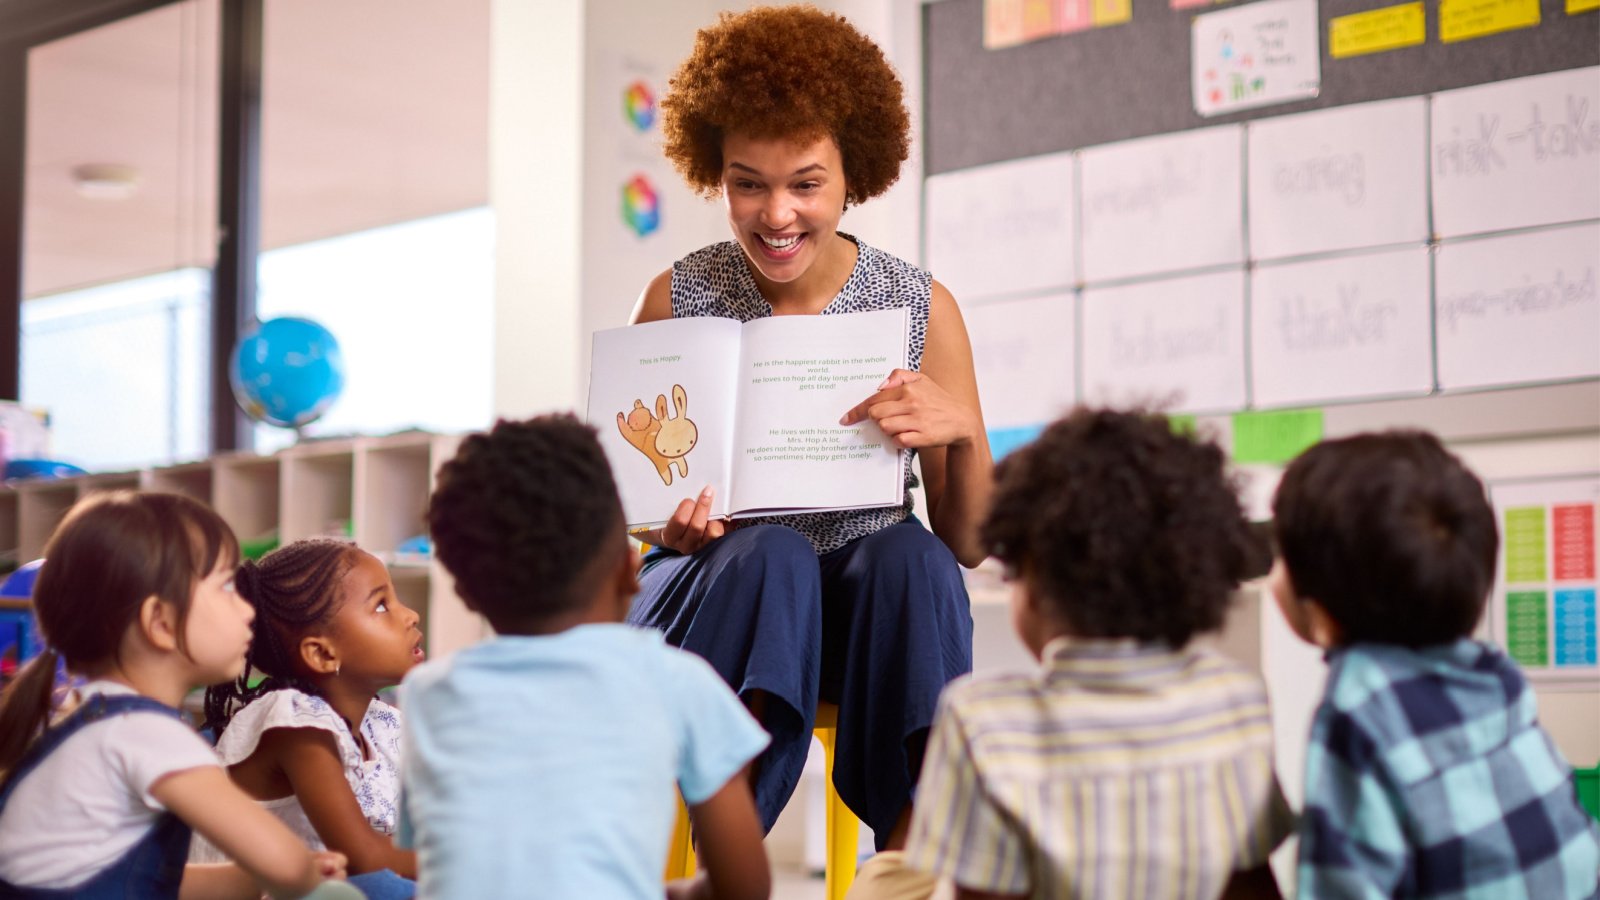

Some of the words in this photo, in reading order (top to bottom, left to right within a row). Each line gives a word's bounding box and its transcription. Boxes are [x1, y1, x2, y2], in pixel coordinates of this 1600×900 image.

[786, 359, 817, 367] happiest
[818, 375, 830, 383] day
[832, 374, 848, 383] long
[806, 454, 829, 462] Hoppy
[848, 452, 872, 460] lonely.
